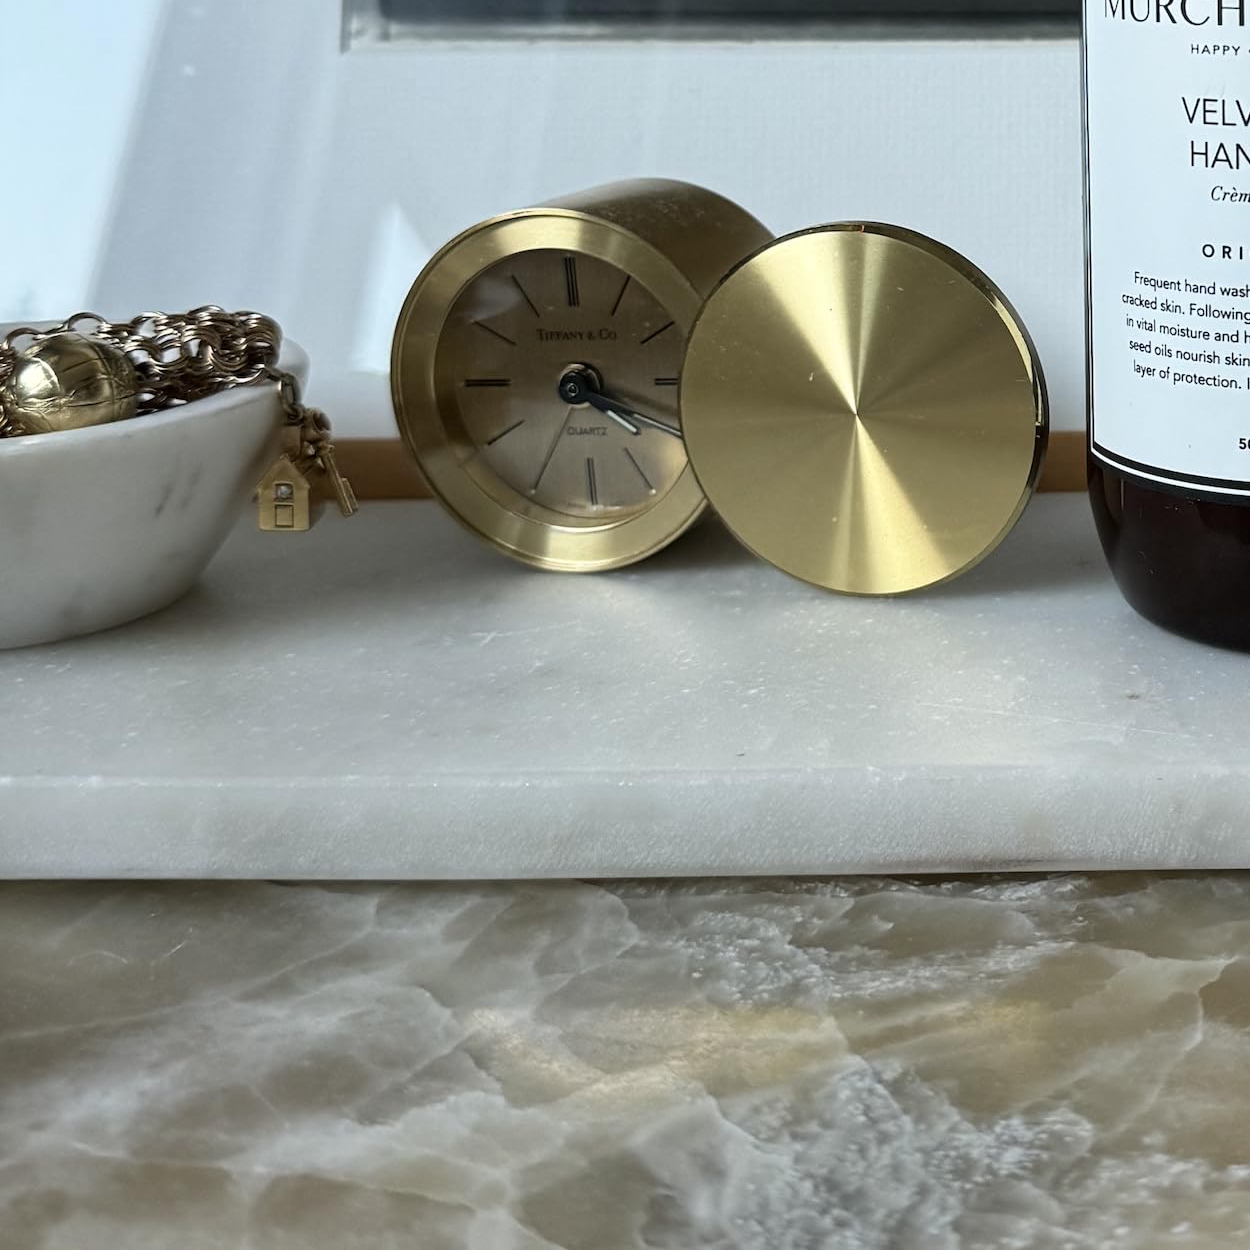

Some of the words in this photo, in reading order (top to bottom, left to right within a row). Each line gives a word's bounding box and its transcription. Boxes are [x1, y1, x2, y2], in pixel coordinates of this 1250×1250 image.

[1190, 43, 1241, 57] HAPPY
[1134, 270, 1182, 293] Frequent
[1184, 278, 1216, 296] hand
[1121, 293, 1158, 311] cracked
[1159, 297, 1186, 315] skin.
[1125, 313, 1135, 328] in
[1135, 318, 1157, 333] vital
[1159, 323, 1211, 341] moisture
[1213, 329, 1240, 344] and
[1128, 340, 1152, 354] seed
[1153, 343, 1173, 359] oils
[1175, 349, 1221, 365] nourish
[1224, 351, 1250, 368] skin
[1133, 358, 1157, 379] layer
[1158, 365, 1171, 380] of
[1172, 372, 1243, 390] protection.
[567, 425, 609, 437] QUARTZ
